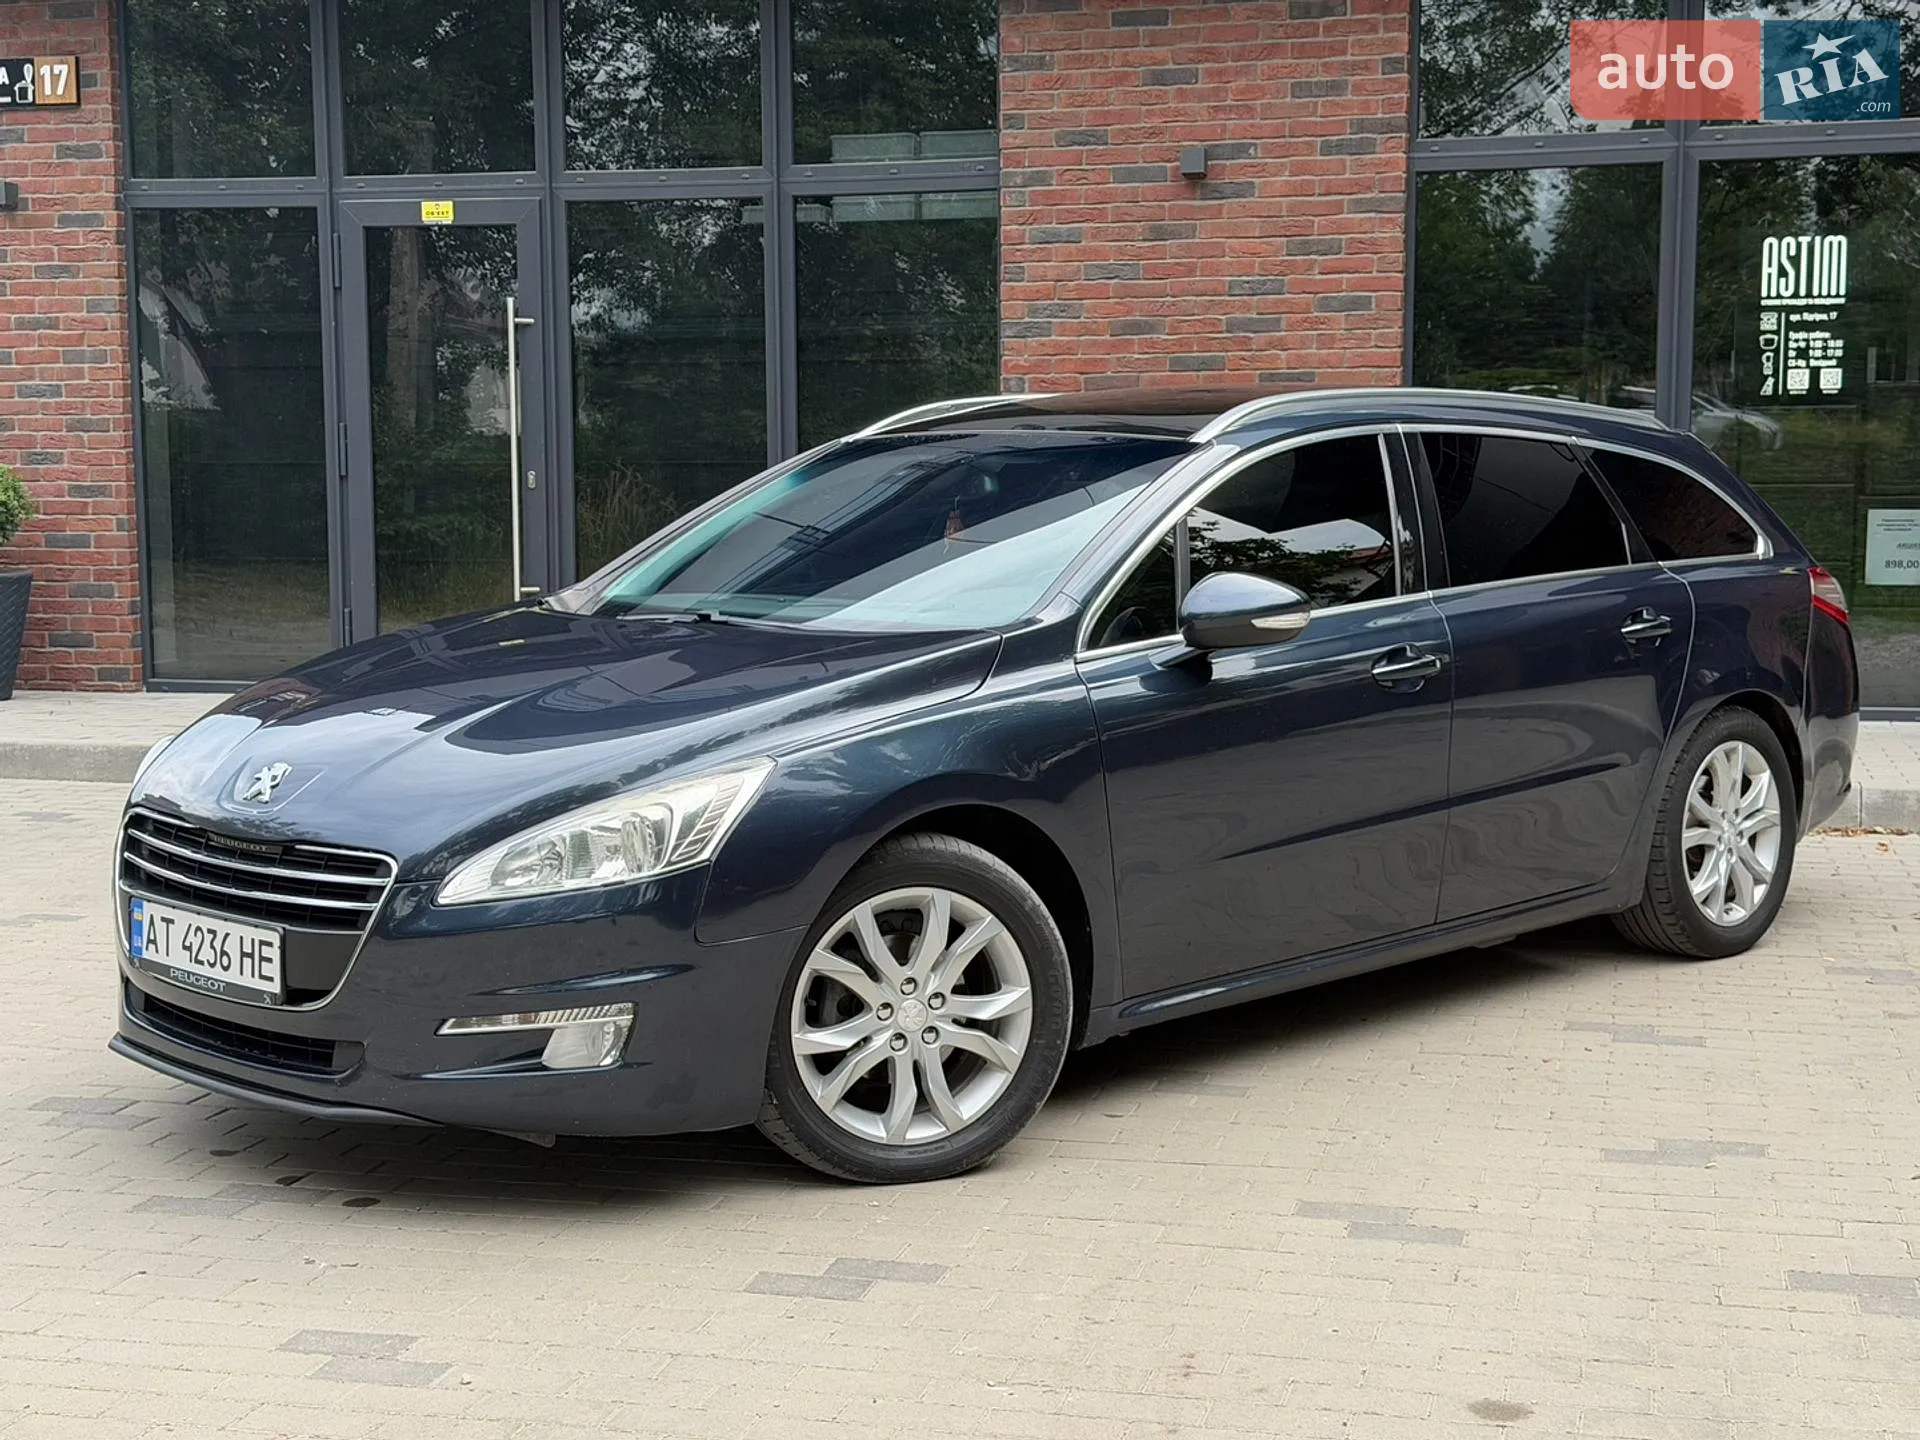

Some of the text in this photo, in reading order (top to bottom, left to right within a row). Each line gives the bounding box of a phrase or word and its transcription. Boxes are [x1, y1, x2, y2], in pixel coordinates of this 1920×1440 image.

[39, 64, 69, 96] 17
[1761, 234, 1848, 298] ASTIM
[145, 913, 275, 983] AT 4236 HE
[170, 967, 227, 993] PEUGEOT
